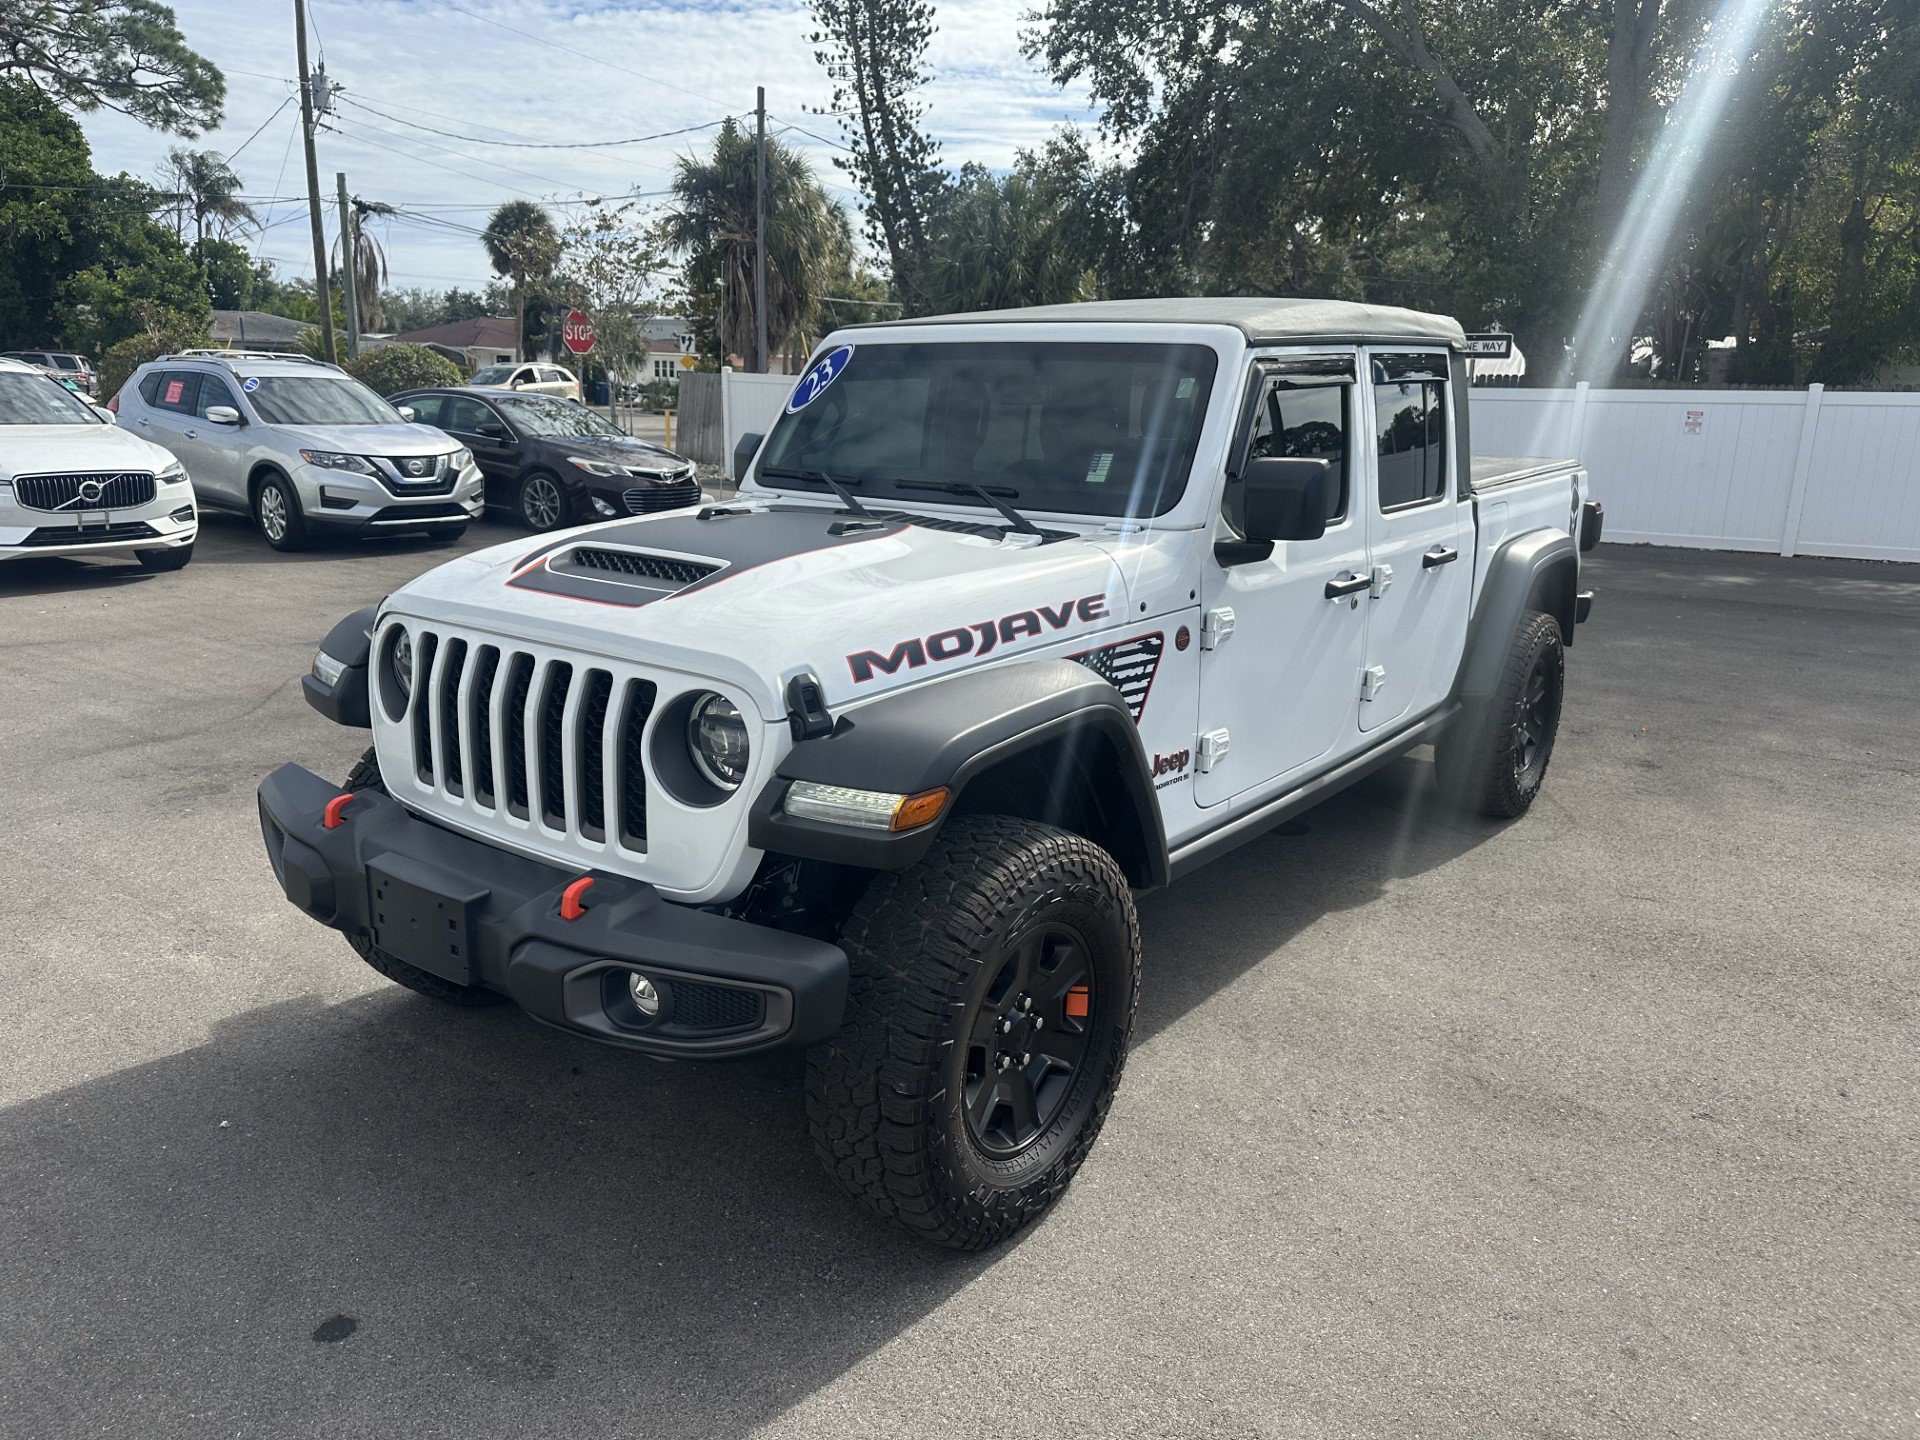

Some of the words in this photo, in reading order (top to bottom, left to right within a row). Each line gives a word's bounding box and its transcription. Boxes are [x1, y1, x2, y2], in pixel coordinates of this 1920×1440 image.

[565, 321, 592, 341] STOP
[1465, 342, 1478, 351] NE
[1483, 342, 1503, 351] WAY
[805, 358, 833, 401] 23
[846, 593, 1110, 683] MOJAVE
[1150, 748, 1190, 778] Jeep
[1154, 776, 1183, 790] ADIATOR
